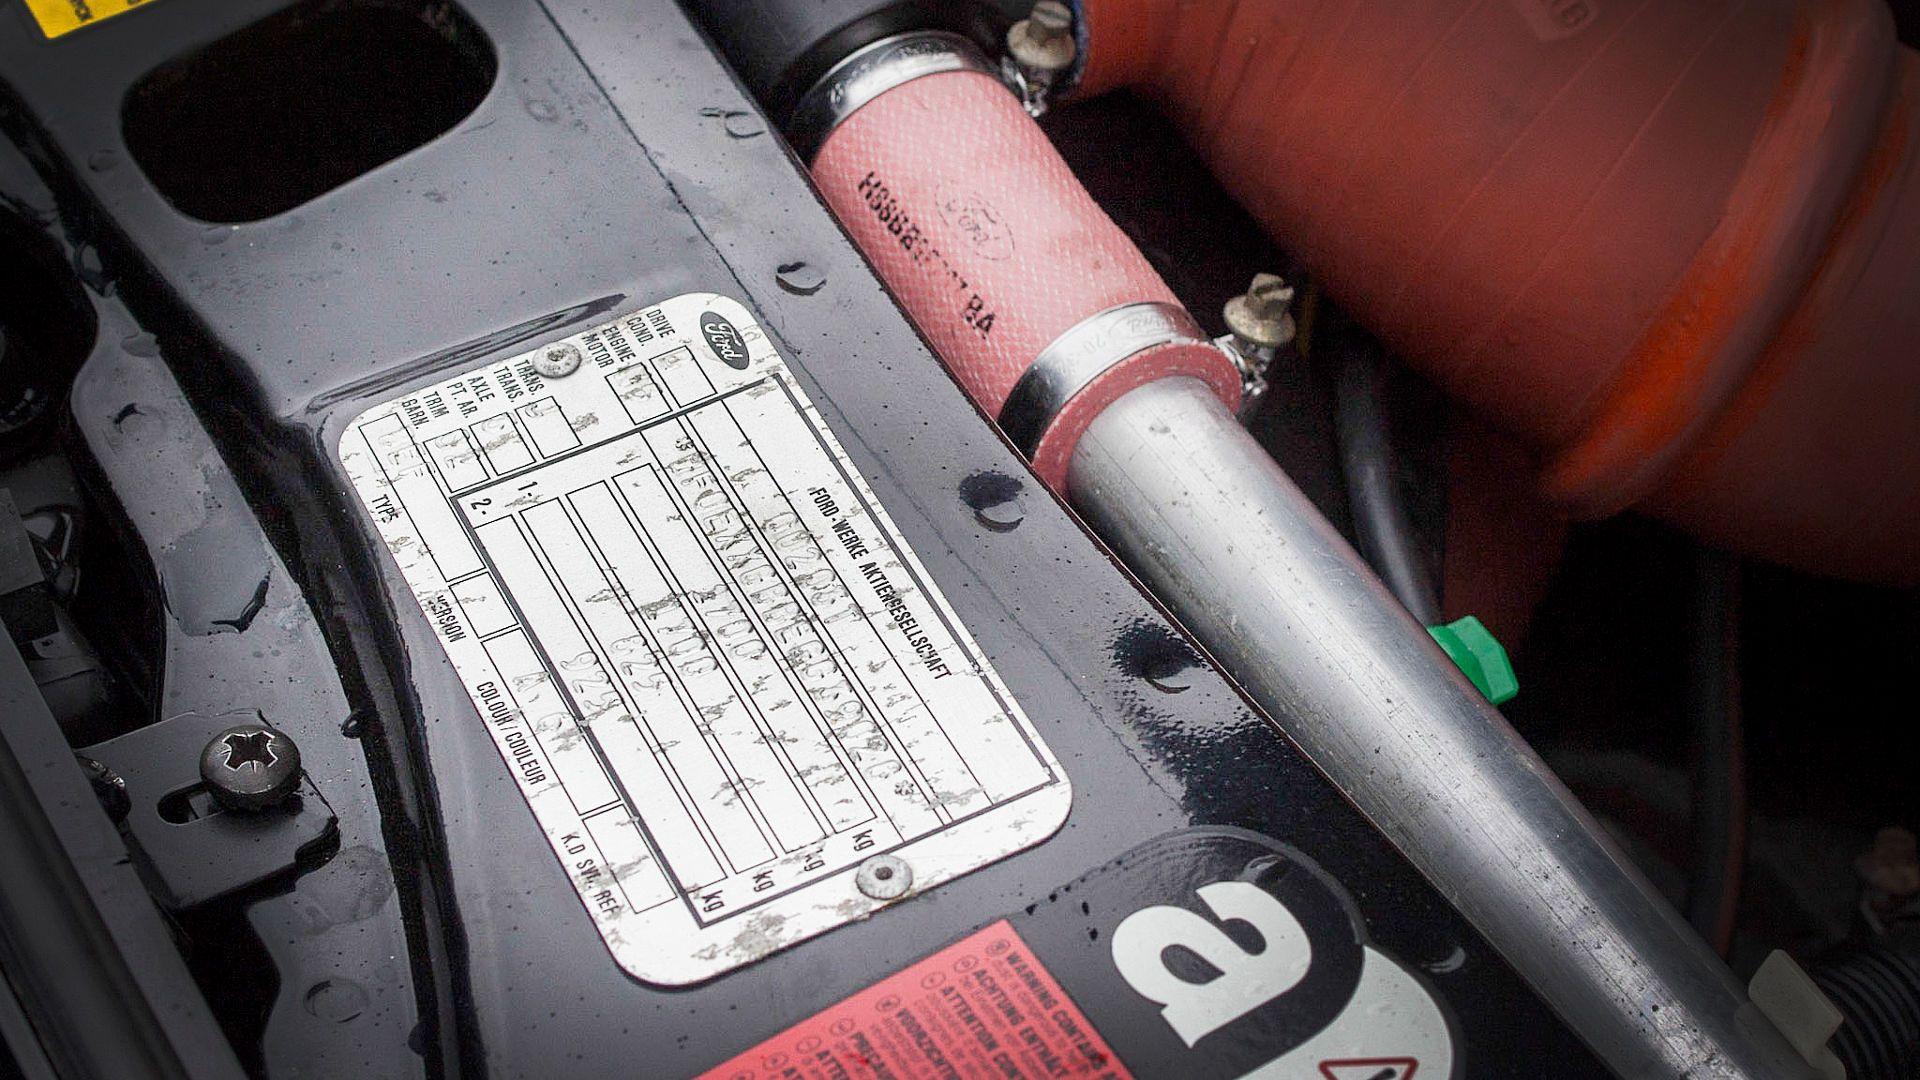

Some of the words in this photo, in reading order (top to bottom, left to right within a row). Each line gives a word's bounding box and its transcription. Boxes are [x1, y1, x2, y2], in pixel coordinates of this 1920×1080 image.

[627, 317, 653, 346] COND.
[646, 309, 675, 338] DRIVE
[581, 333, 614, 368] MOTOR
[602, 325, 636, 362] ENGINE
[703, 316, 746, 363] Ford
[468, 377, 495, 402] AXLE
[494, 366, 523, 402] TRANS.
[402, 399, 429, 429] GARN.
[424, 391, 449, 418] TRIM
[447, 382, 467, 399] PT.
[457, 401, 477, 418] AR.
[853, 830, 874, 851] kg
[753, 871, 774, 892] kg
[701, 890, 724, 912] kg
[1111, 881, 1312, 1049] a
